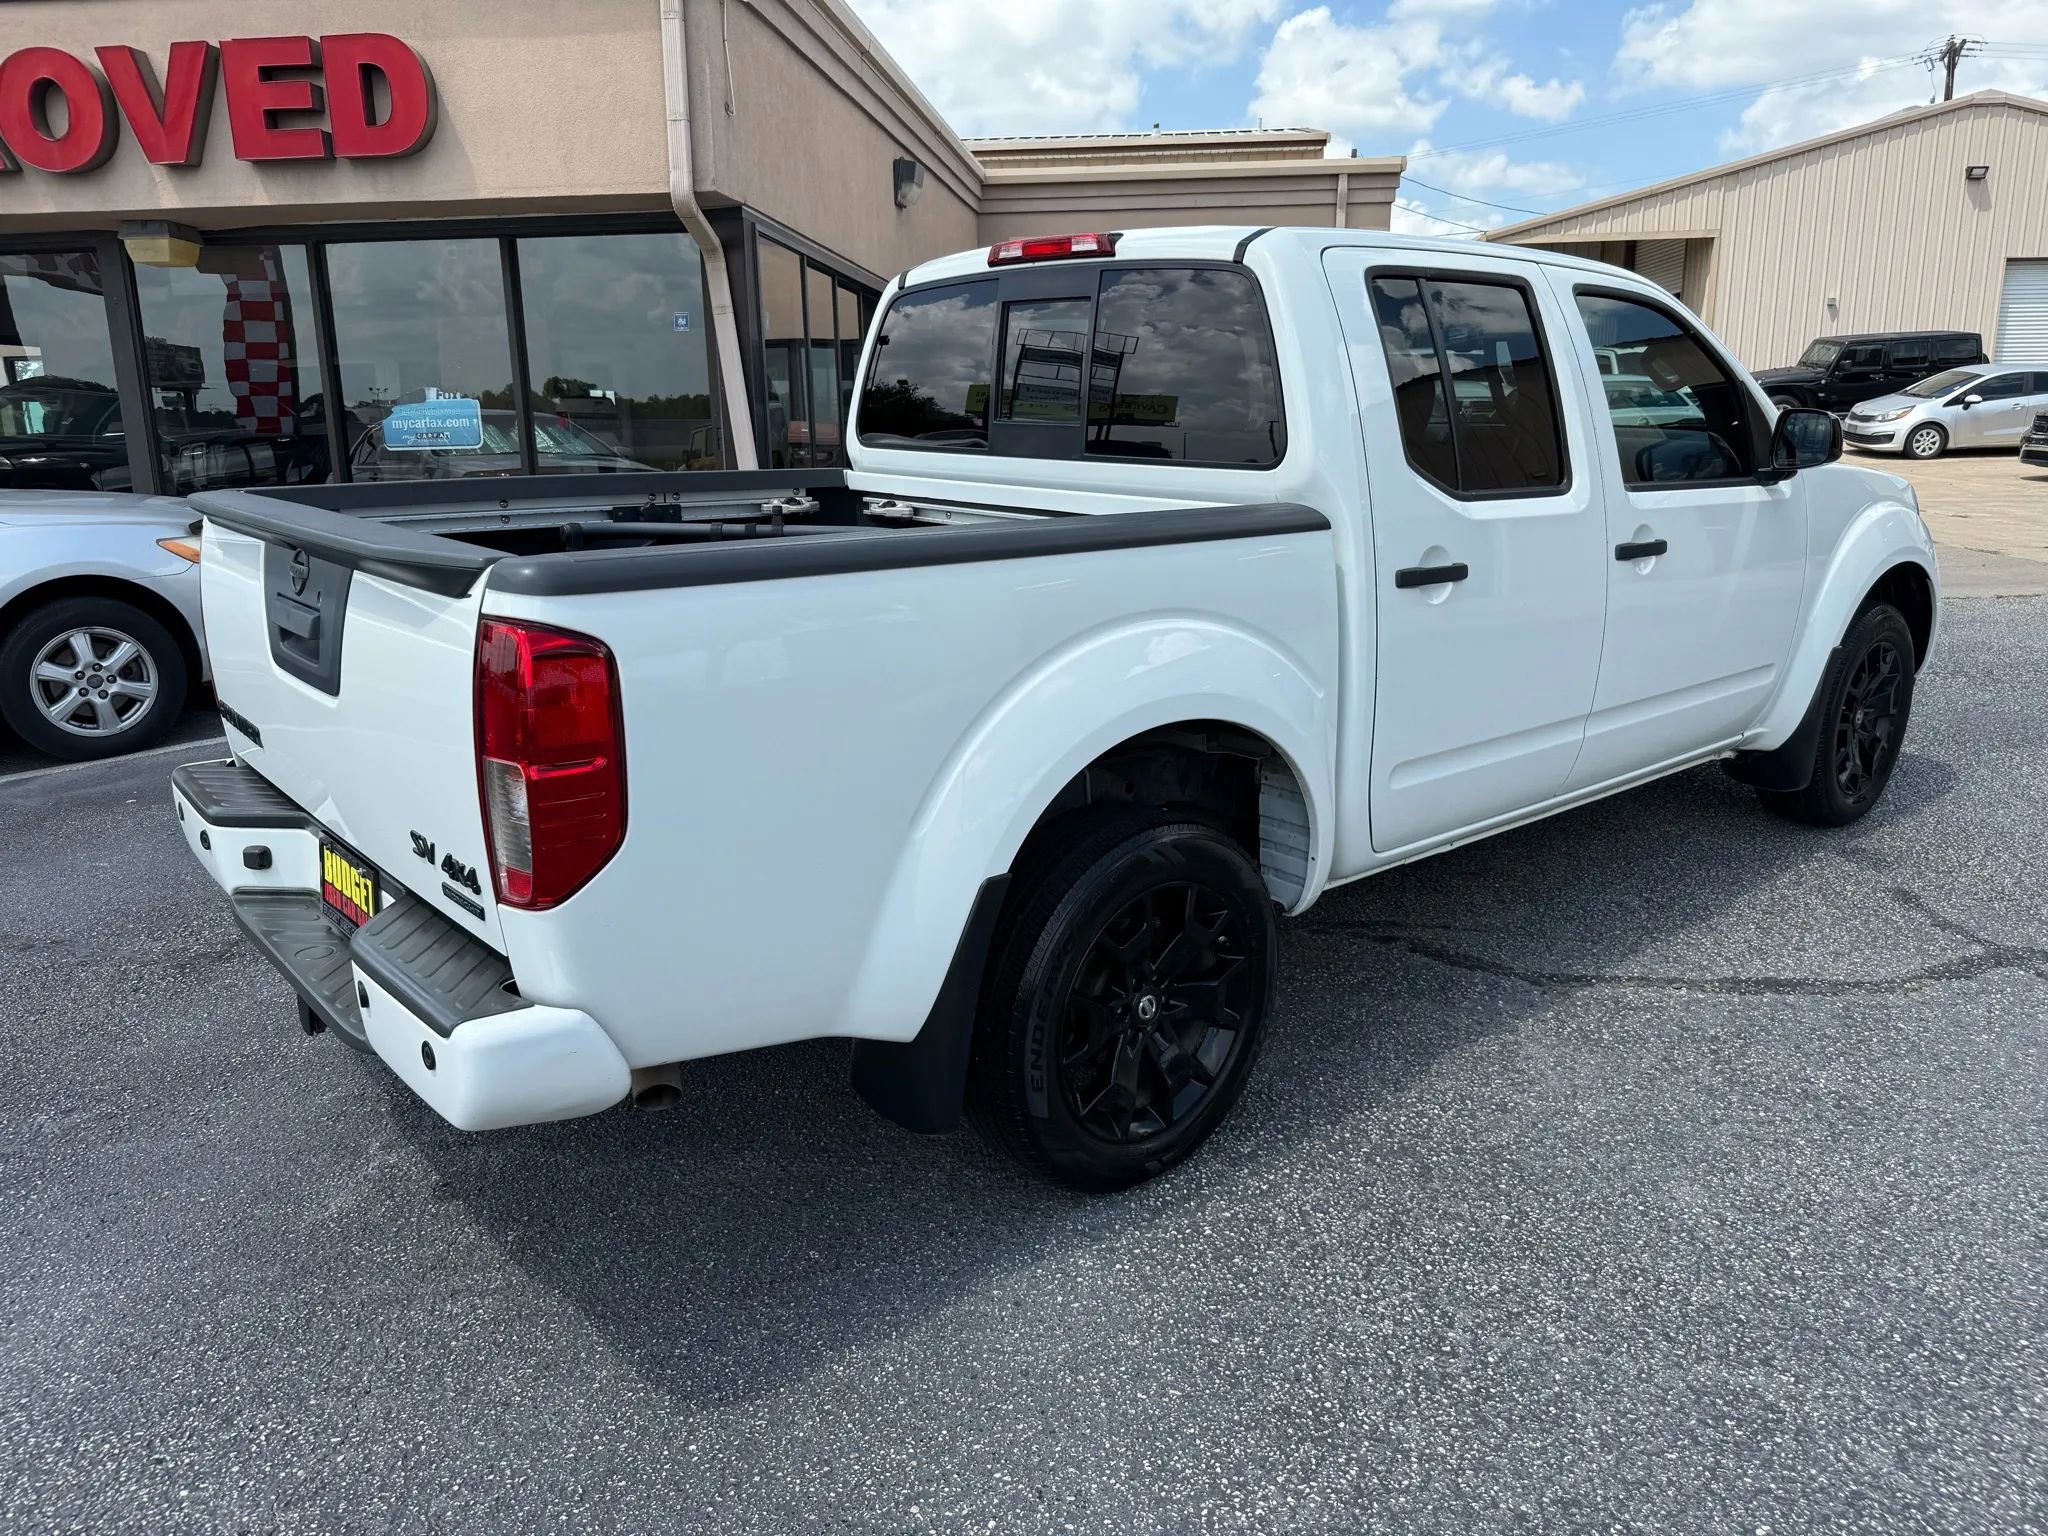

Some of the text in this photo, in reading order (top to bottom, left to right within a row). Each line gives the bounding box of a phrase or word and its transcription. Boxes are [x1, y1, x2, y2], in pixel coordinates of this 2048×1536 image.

[0, 33, 438, 174] OVED
[391, 417, 470, 431] mycarfax.com
[323, 845, 374, 918] BUDGET
